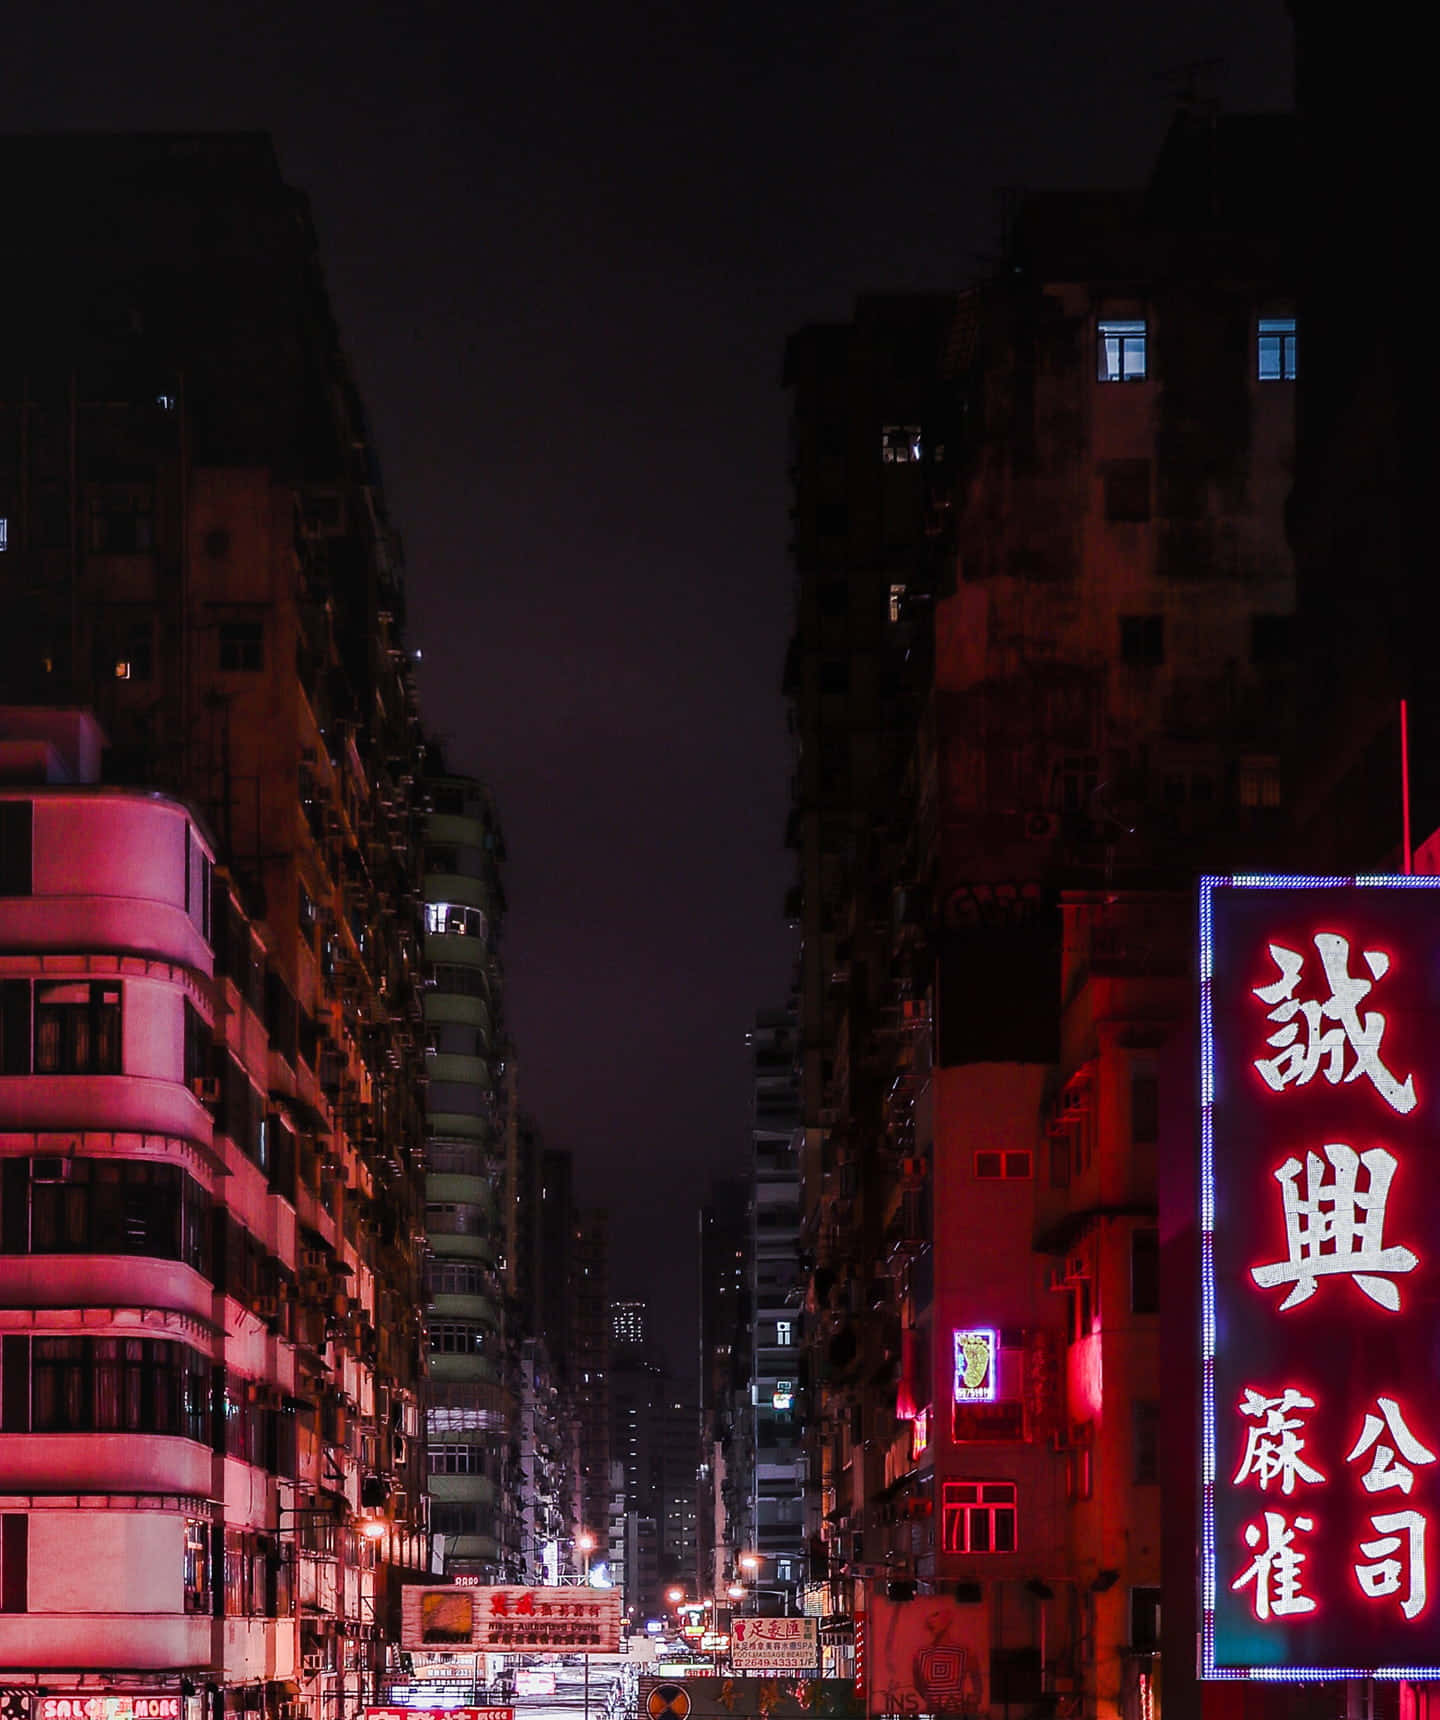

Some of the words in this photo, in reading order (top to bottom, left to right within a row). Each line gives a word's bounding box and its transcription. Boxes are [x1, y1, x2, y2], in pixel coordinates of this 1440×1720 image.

[1251, 932, 1418, 1312] 誠興
[1345, 1397, 1437, 1619] 公司
[135, 1700, 178, 1717] MORE
